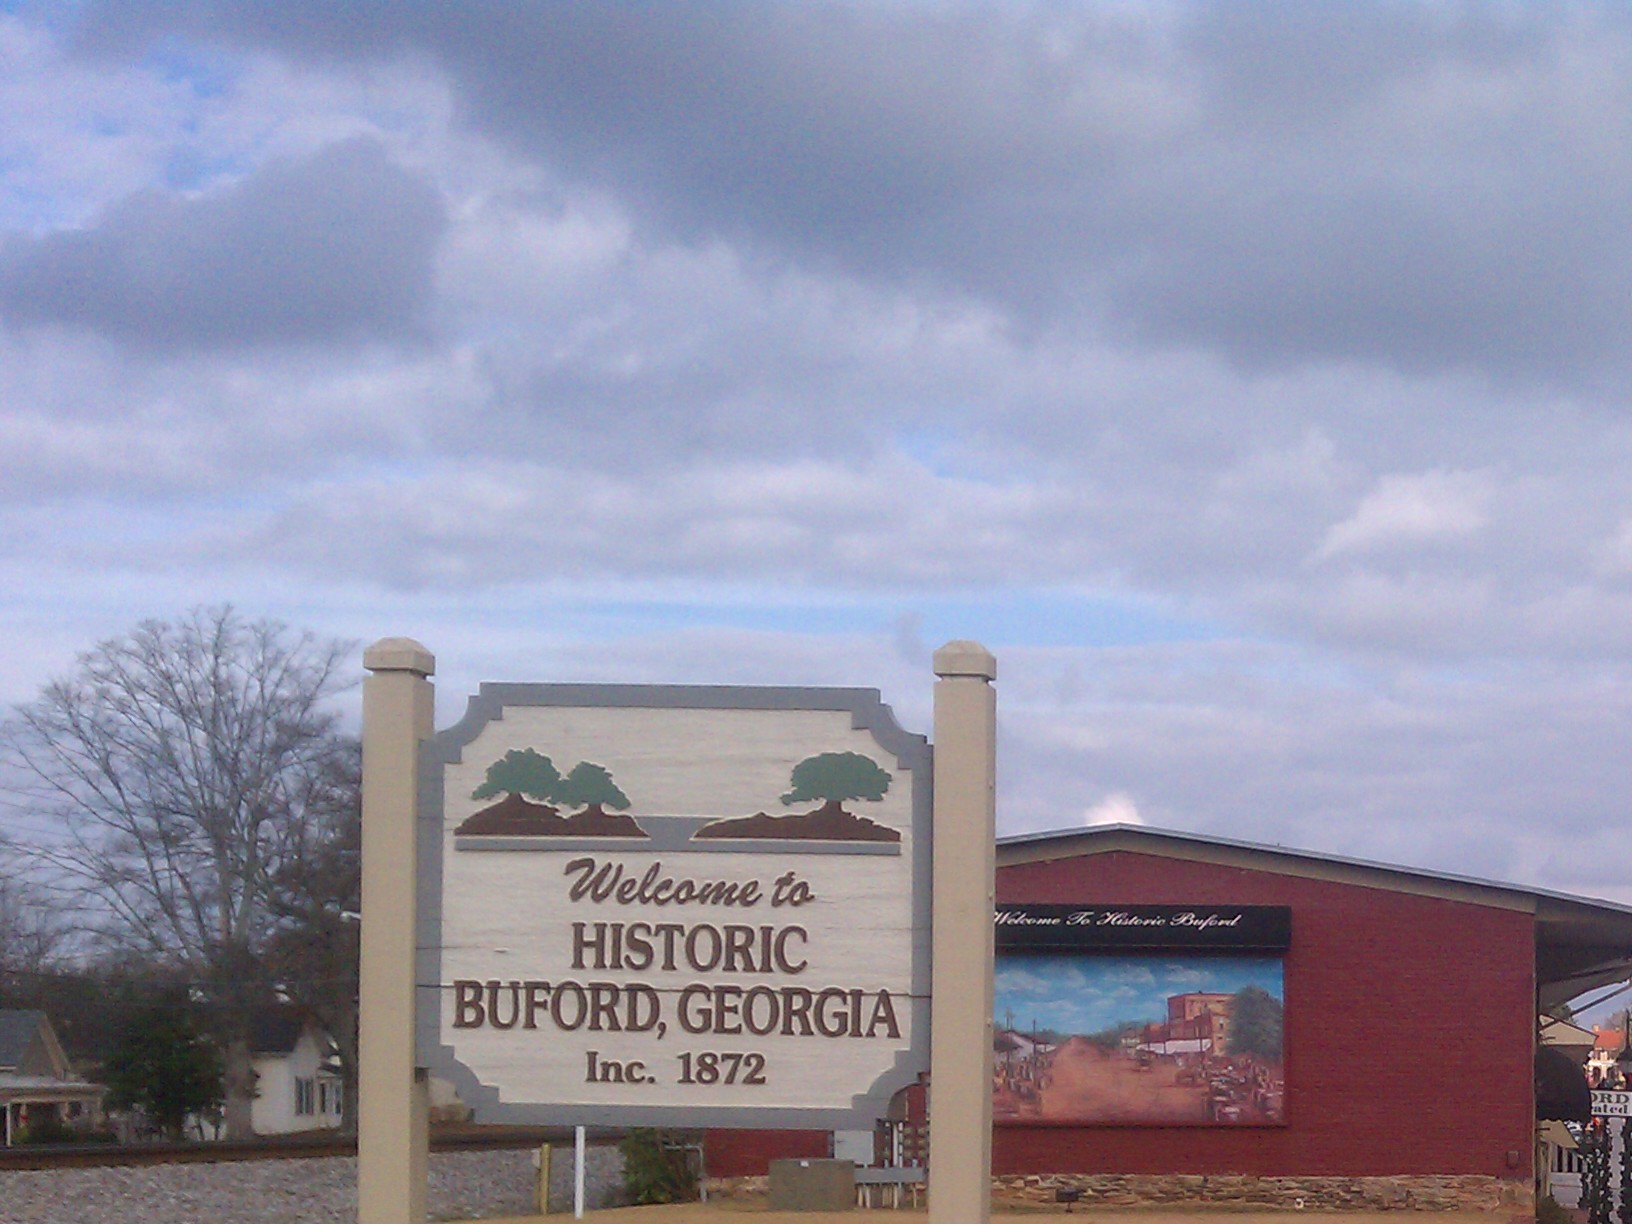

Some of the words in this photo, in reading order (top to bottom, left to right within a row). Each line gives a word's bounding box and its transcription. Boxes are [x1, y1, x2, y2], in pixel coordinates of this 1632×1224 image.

[564, 857, 762, 907] Welcome
[771, 871, 815, 908] to
[993, 911, 1060, 926] Welcome
[1065, 911, 1094, 926] To
[1096, 911, 1166, 926] Historic
[1169, 912, 1242, 931] Buford
[571, 922, 808, 974] HISTORIC
[452, 979, 667, 1039] BUFORD,
[677, 984, 901, 1038] GEORGIA
[585, 1051, 655, 1084] Inc.
[677, 1053, 766, 1084] 1872
